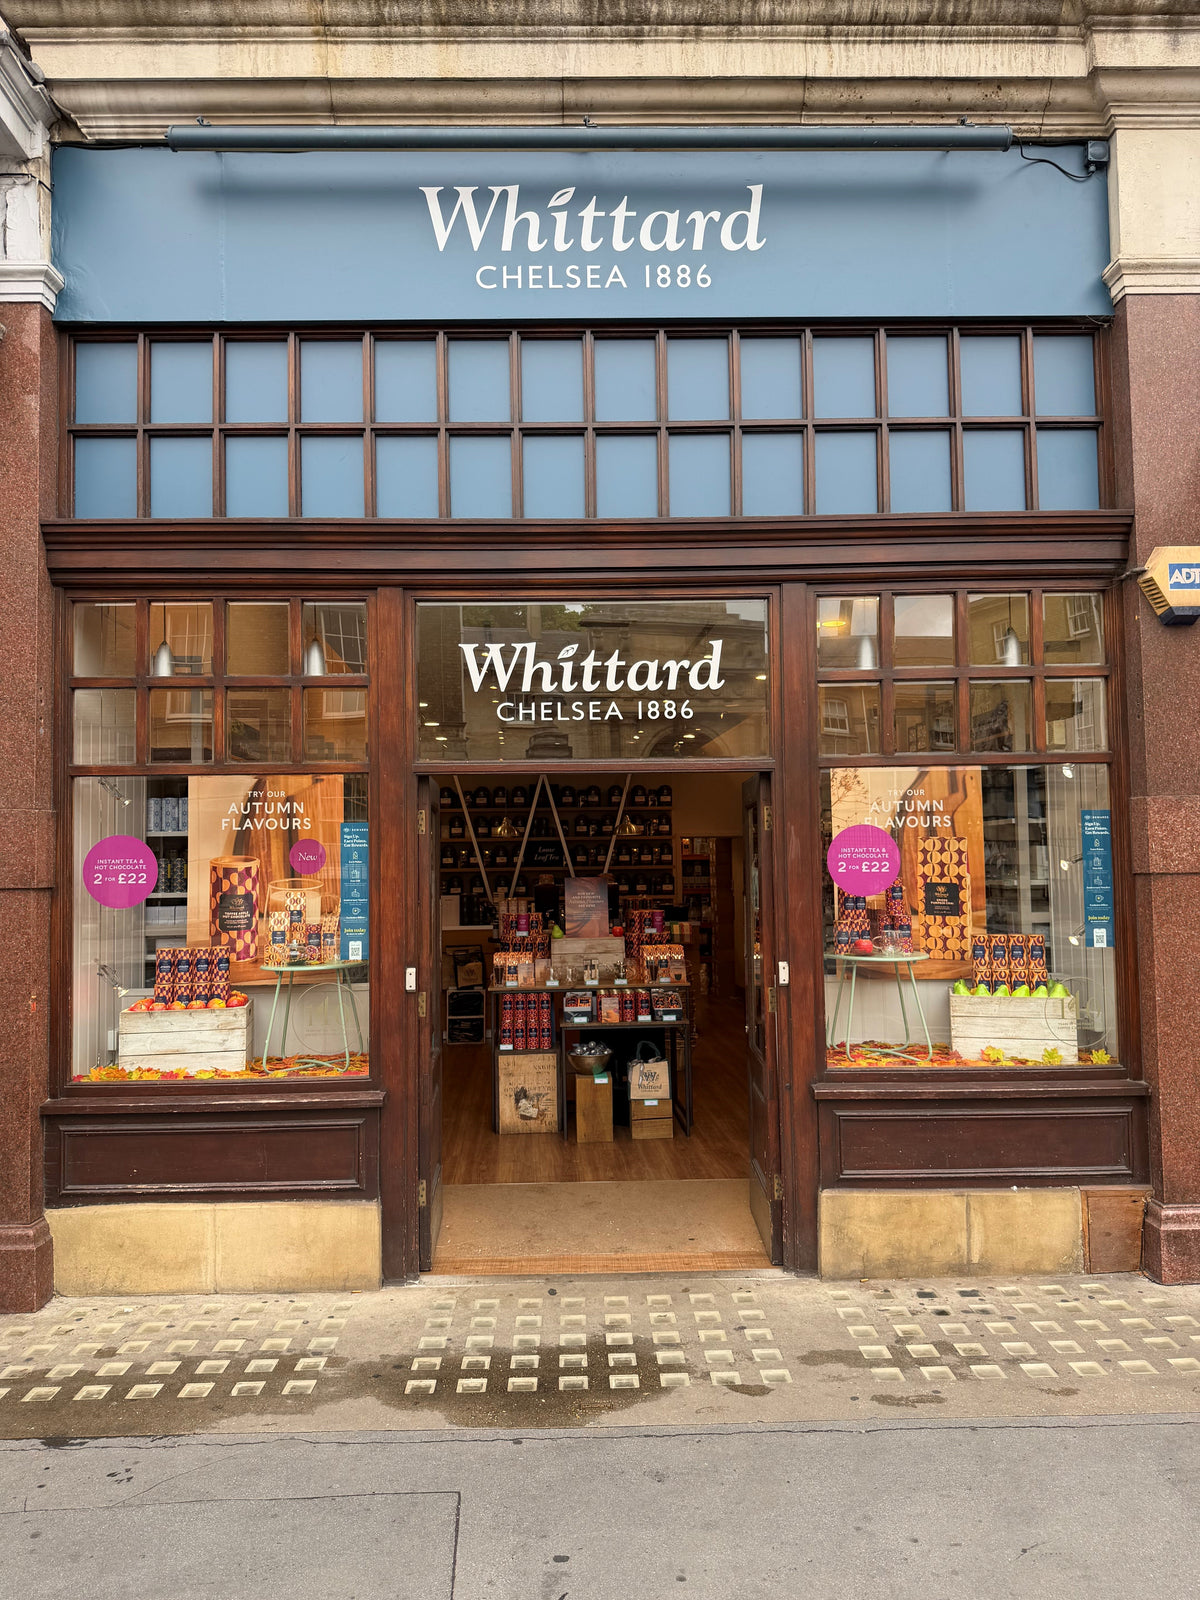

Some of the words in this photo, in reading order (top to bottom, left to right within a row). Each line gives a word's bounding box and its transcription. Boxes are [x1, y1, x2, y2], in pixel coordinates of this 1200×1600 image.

[418, 183, 767, 253] Whittard
[475, 265, 628, 290] CHELSEA
[644, 263, 713, 289] 1886
[458, 639, 726, 693] Whittard
[496, 701, 624, 722] CHELSEA
[637, 699, 695, 720] 1886
[247, 790, 264, 798] TRY
[266, 790, 286, 798] OUR
[887, 789, 904, 797] TRY
[906, 788, 926, 796] OUR
[227, 801, 304, 815] AUTUMN
[870, 799, 944, 814] AUTUMN
[221, 817, 312, 831] FLAVOURS
[864, 815, 952, 829] FLAVOURS
[298, 852, 318, 862] New
[838, 861, 847, 872] 2
[862, 861, 890, 872] £22
[93, 873, 103, 885] 2
[118, 873, 147, 884] £22
